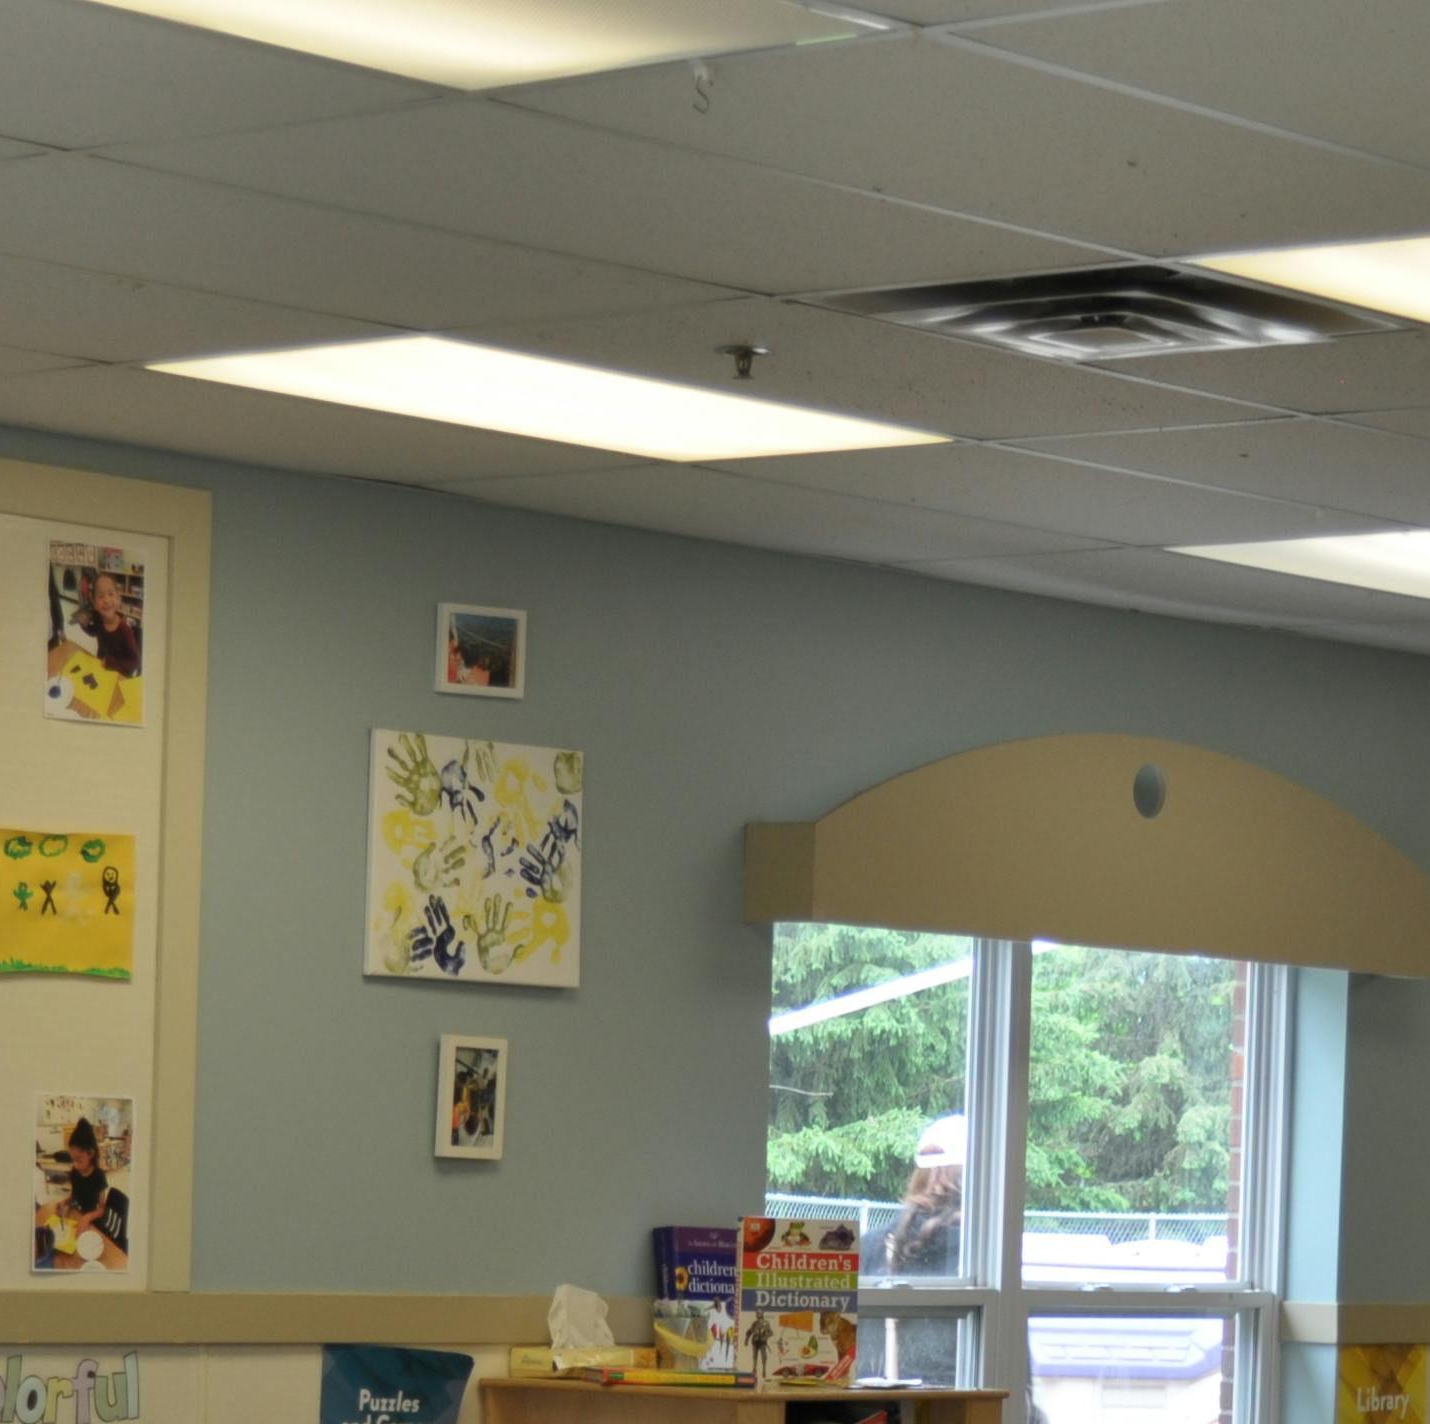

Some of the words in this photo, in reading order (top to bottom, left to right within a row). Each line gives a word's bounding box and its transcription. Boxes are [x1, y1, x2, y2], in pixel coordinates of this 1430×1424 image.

[756, 1253, 852, 1271] Children's
[688, 1278, 735, 1293] dictiona
[755, 1272, 851, 1289] Illustrated
[755, 1290, 851, 1314] Dictionary
[358, 1388, 420, 1413] Puzzles
[1356, 1388, 1410, 1419] Library
